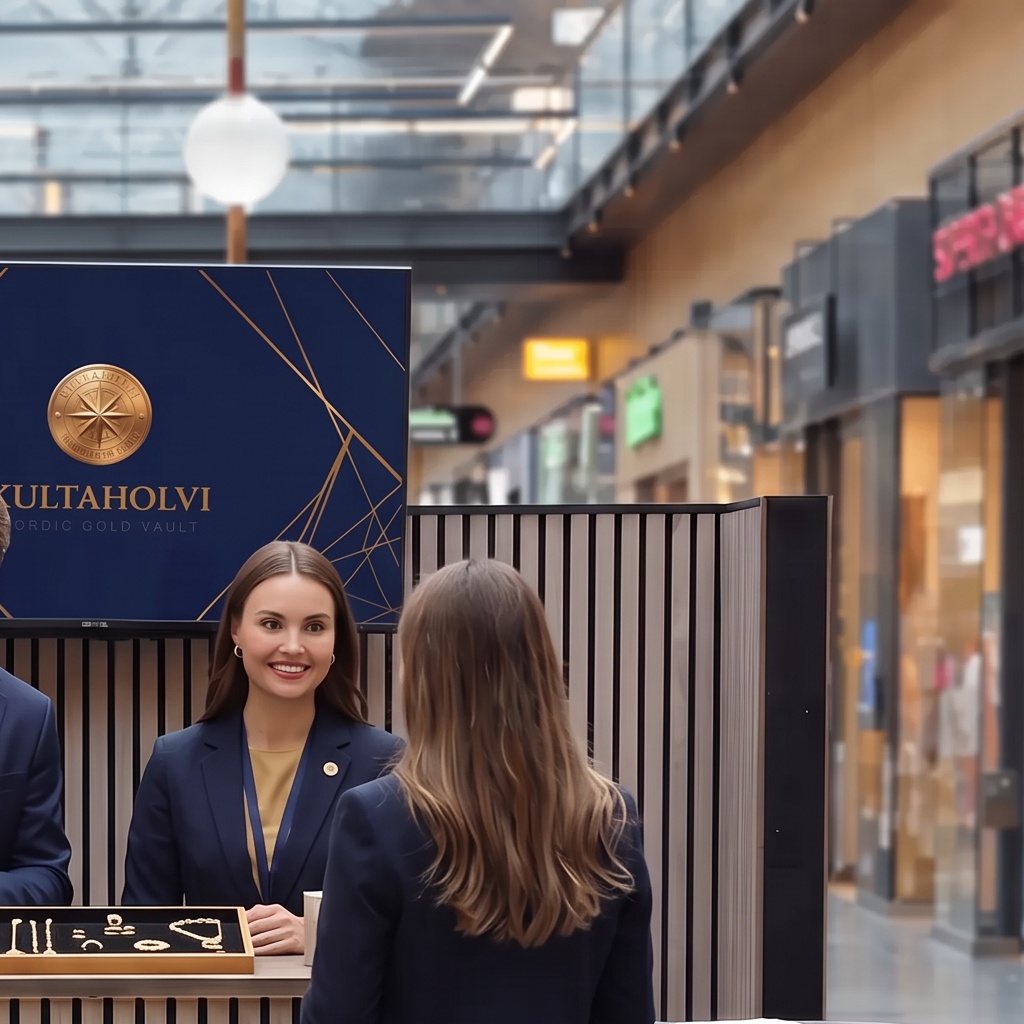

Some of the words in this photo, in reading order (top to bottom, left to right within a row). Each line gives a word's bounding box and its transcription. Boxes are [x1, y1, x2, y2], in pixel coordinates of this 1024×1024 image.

[12, 519, 72, 532] ORDIC
[82, 520, 131, 533] GOLD
[141, 521, 199, 534] VAULT
